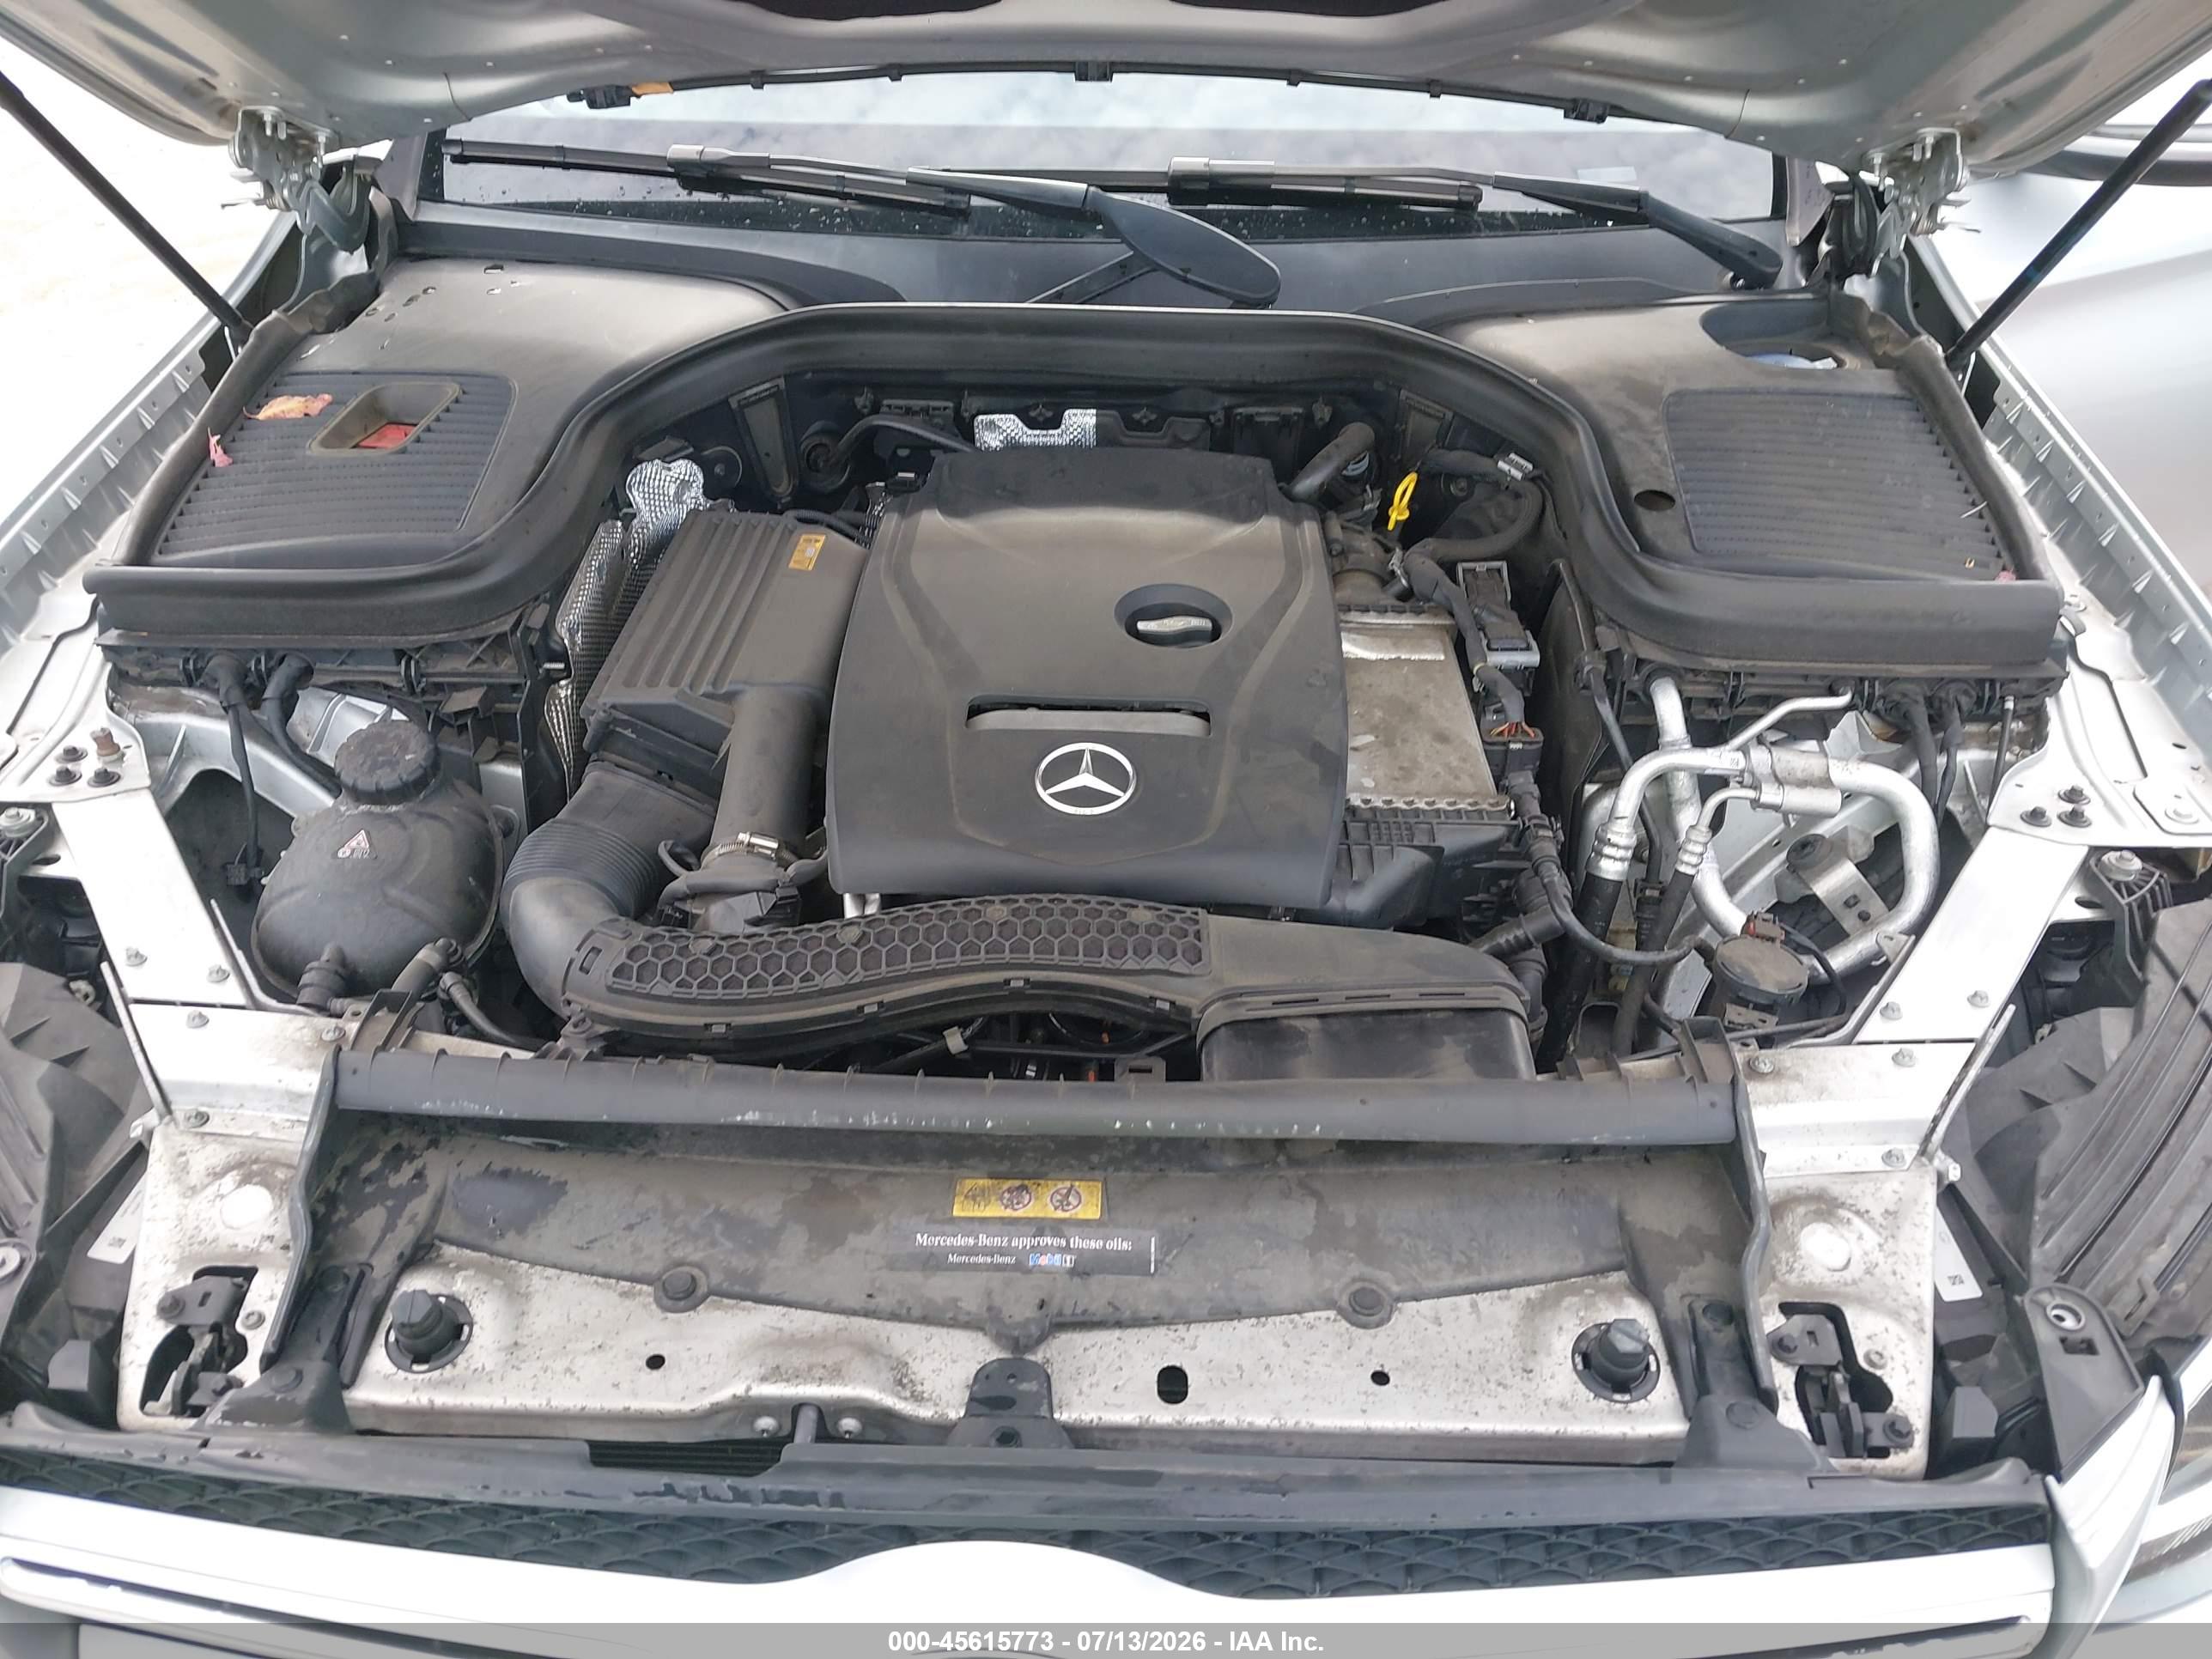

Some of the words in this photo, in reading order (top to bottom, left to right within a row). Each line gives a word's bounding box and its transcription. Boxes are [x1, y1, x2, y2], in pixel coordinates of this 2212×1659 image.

[915, 1233, 1009, 1247] Mercedes-Benz
[1011, 1236, 1066, 1249] approves
[1070, 1236, 1103, 1249] these
[1105, 1237, 1132, 1251] oils:
[947, 1253, 1017, 1265] Mercedes-Benz
